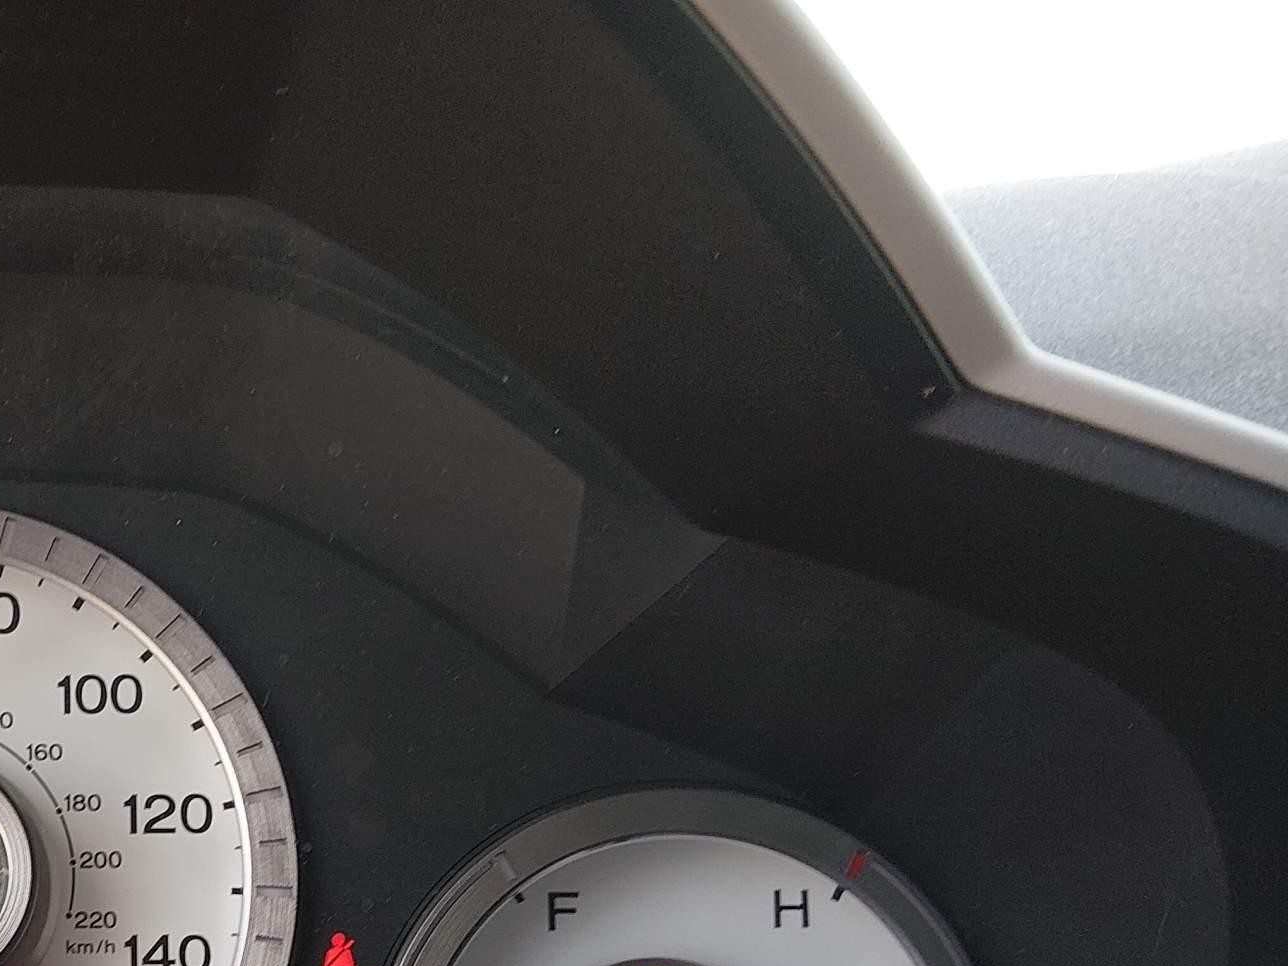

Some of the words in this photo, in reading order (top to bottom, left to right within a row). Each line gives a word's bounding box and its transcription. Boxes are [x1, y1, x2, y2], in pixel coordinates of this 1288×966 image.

[57, 674, 143, 715] 100
[26, 744, 63, 761] 160
[64, 794, 101, 812] 180
[123, 795, 212, 836] 120
[79, 851, 122, 869] 200
[548, 891, 579, 931] F
[774, 889, 809, 928] H
[74, 911, 117, 929] 220
[66, 939, 116, 954] km/h
